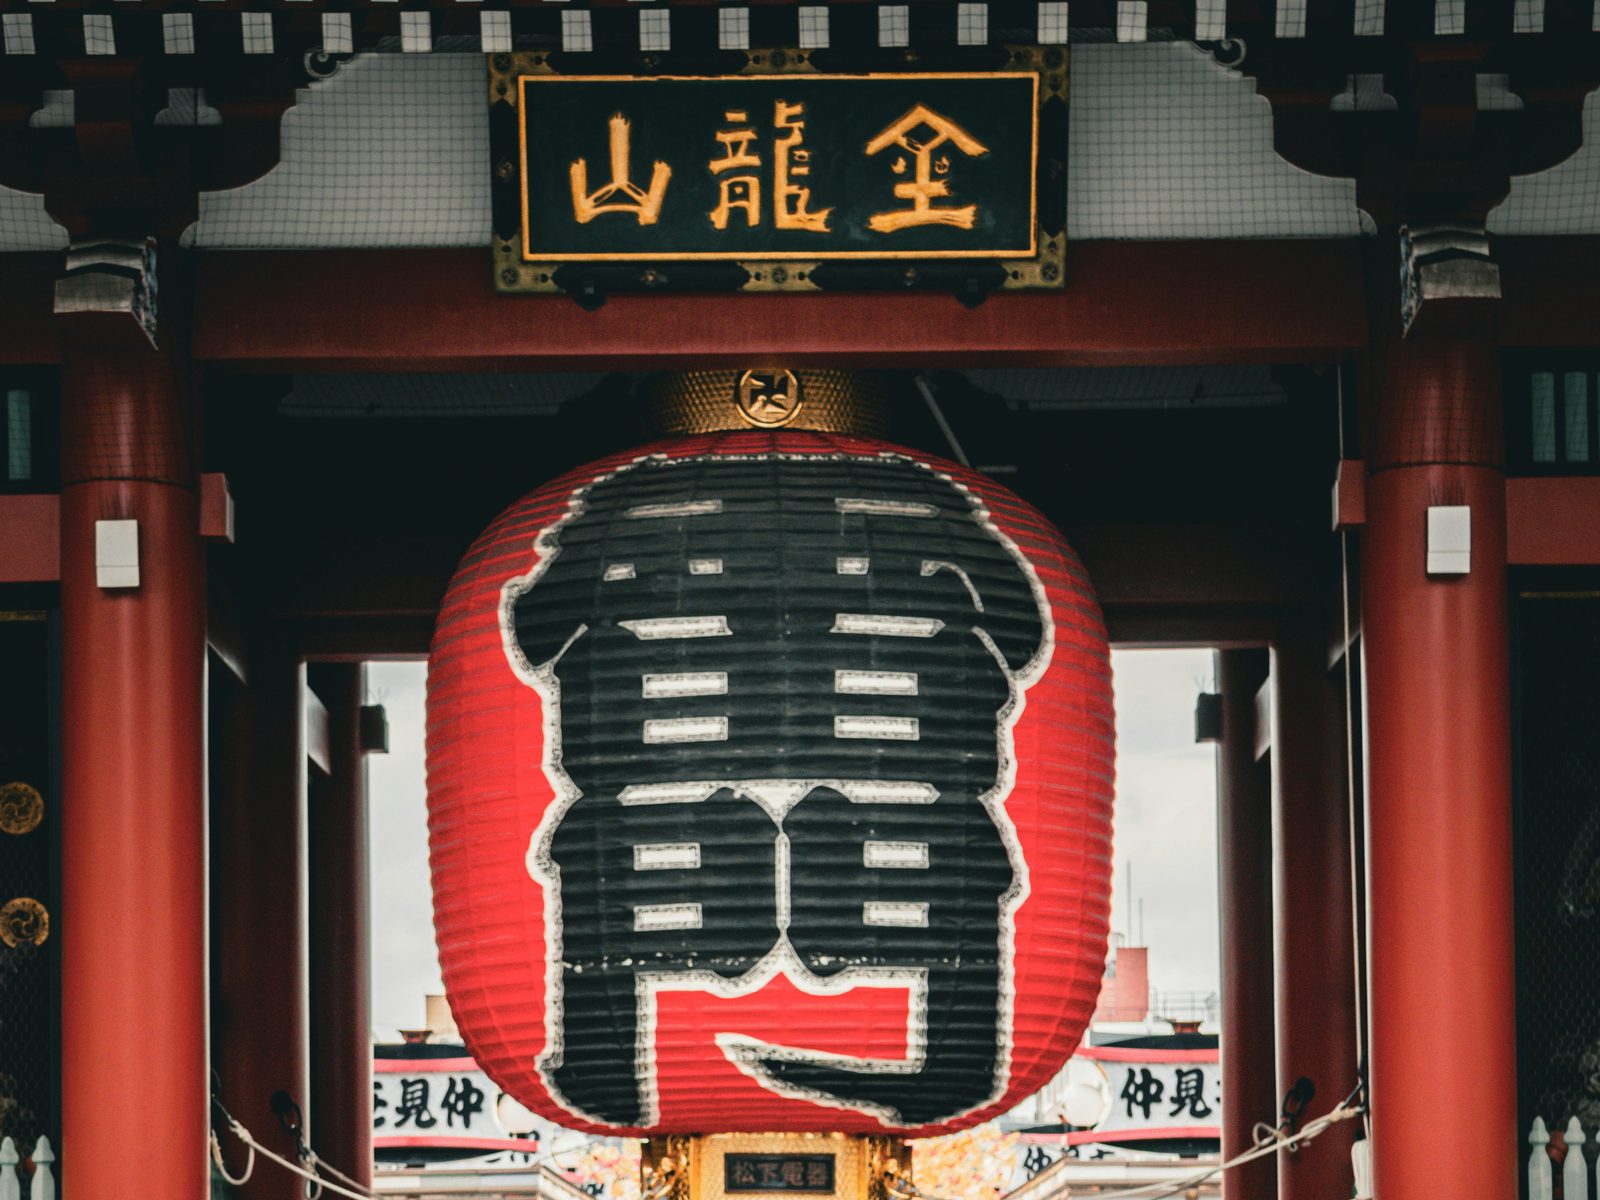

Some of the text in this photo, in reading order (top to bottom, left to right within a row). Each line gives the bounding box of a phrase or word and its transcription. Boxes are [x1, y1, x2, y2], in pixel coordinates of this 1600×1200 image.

[498, 453, 1055, 1130] 雷門
[1120, 1067, 1220, 1119] 仲見
[732, 1160, 829, 1187] 松下電器
